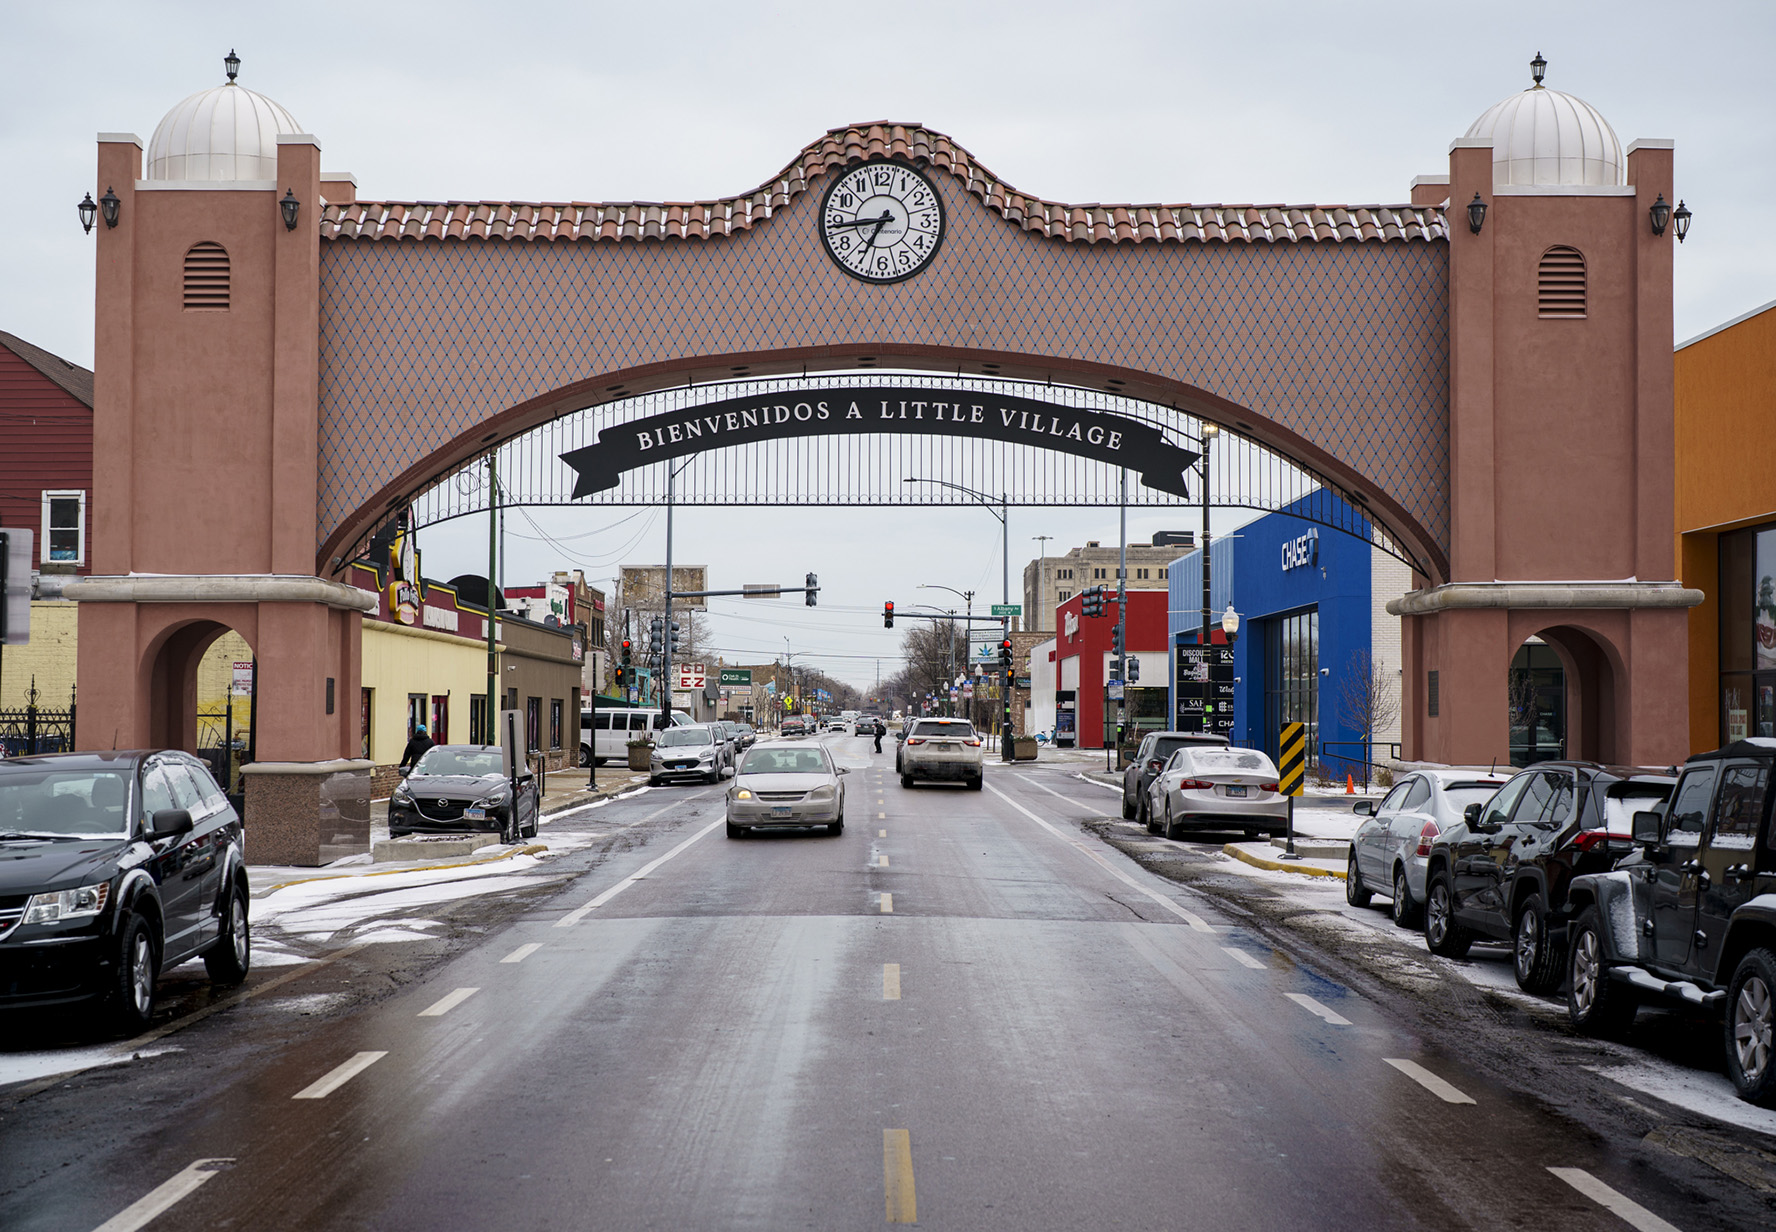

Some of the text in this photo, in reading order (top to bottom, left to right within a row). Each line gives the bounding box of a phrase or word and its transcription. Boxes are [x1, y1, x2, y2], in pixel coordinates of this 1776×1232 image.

[856, 178, 866, 192] 11
[874, 172, 890, 186] 12
[900, 176, 906, 192] 1
[839, 192, 853, 208] 10
[913, 190, 925, 206] 2
[832, 213, 844, 226] 9
[920, 214, 932, 228] 3
[839, 236, 850, 251] 8
[912, 235, 924, 250] 4
[857, 250, 868, 265] 7
[876, 256, 888, 271] 6
[898, 250, 910, 266] 5
[636, 400, 1122, 450] BIENVENIDOS A LITTLE VILLAGE
[1282, 534, 1308, 571] CHASE
